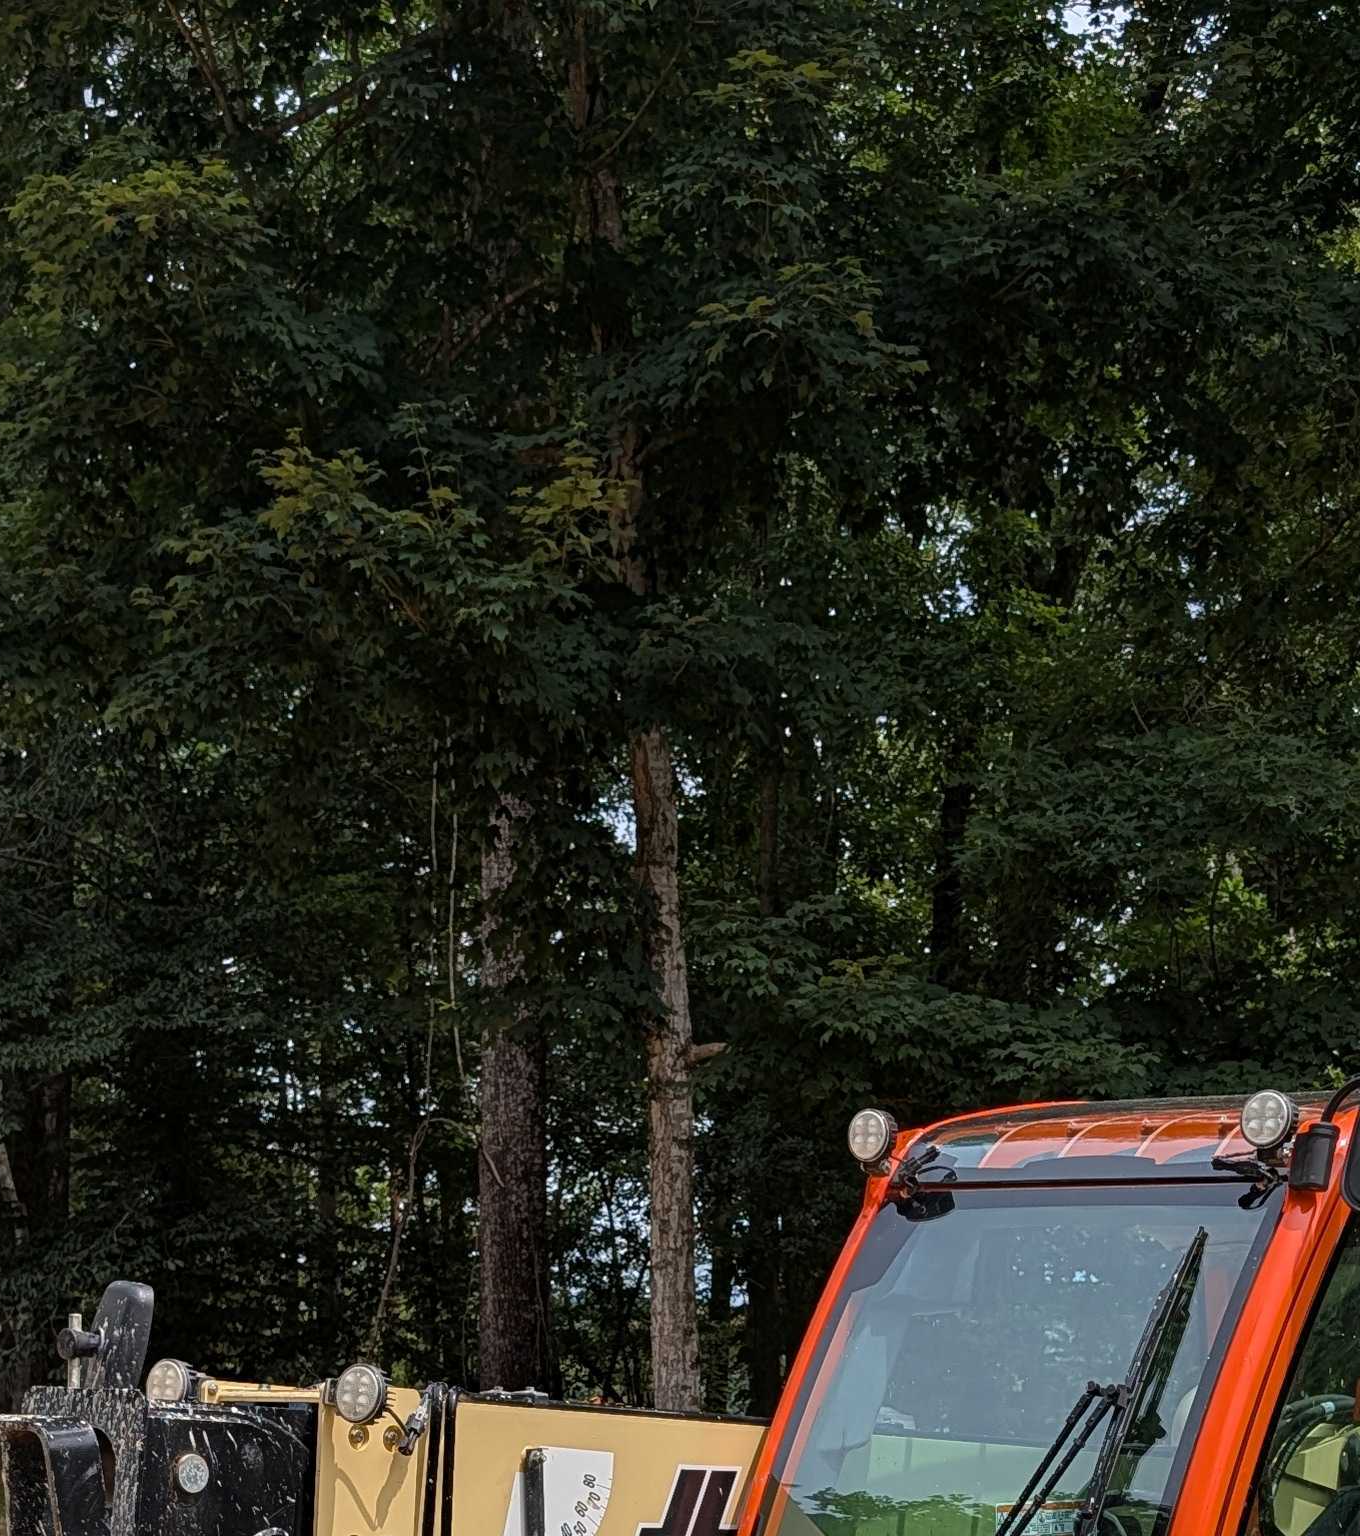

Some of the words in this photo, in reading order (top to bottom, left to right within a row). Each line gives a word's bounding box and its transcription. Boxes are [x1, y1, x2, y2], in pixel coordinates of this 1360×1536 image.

[582, 1473, 596, 1489] 80
[586, 1491, 600, 1509] 70
[574, 1501, 588, 1517] 60
